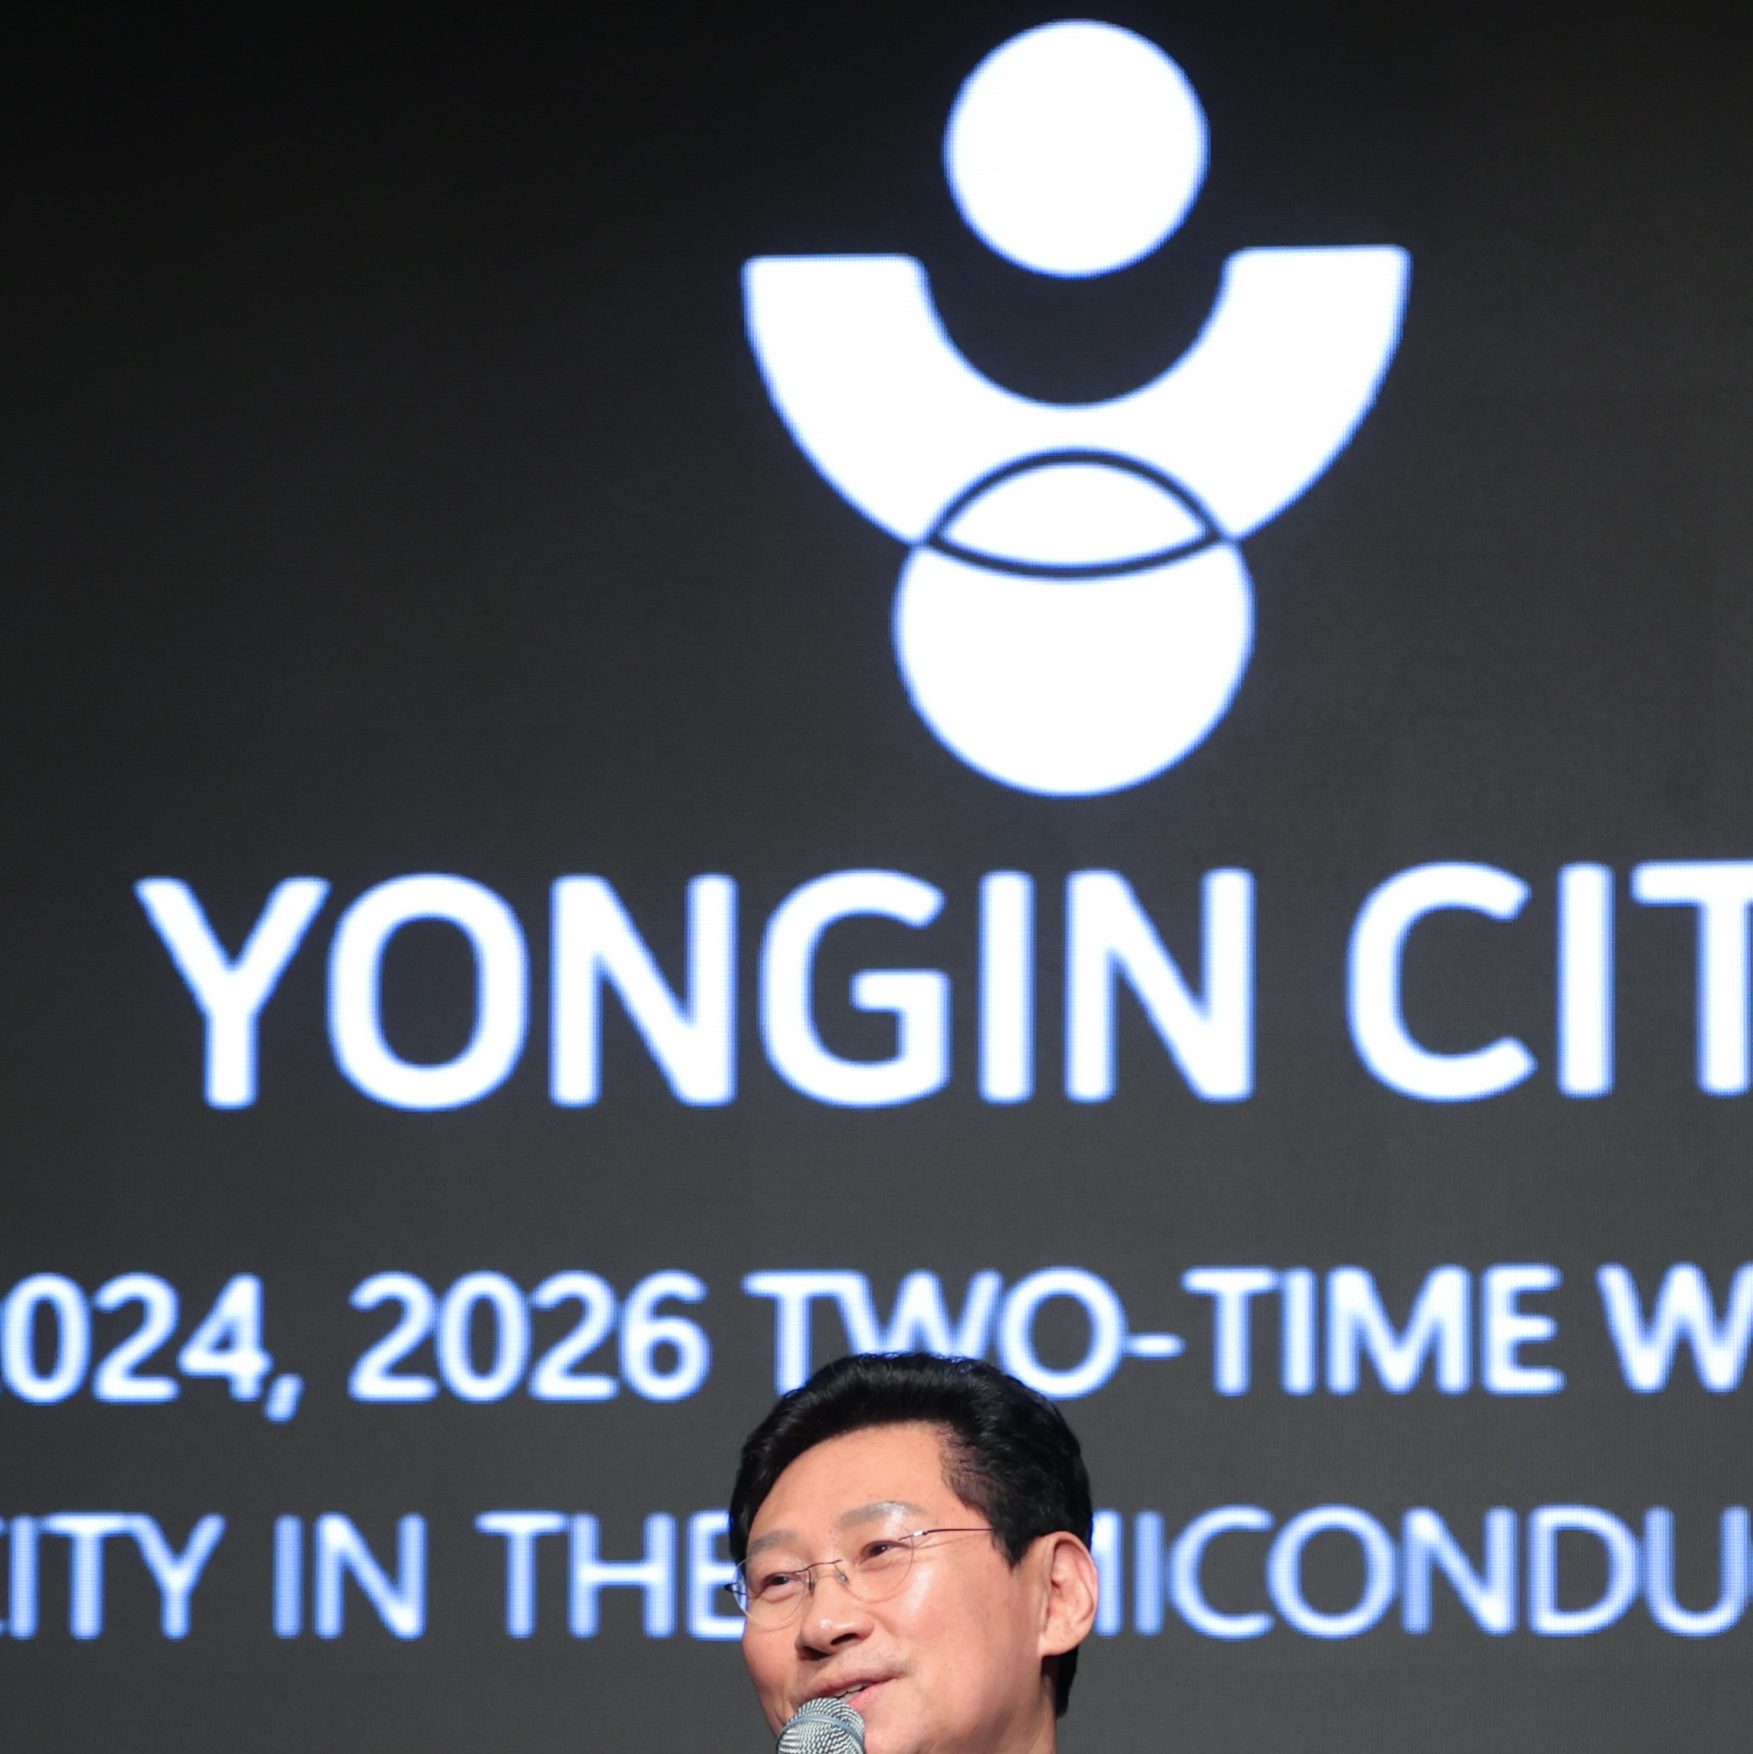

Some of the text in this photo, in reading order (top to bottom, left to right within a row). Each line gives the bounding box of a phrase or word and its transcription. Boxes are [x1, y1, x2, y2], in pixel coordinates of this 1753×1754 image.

[134, 866, 1257, 1113] YONGIN
[349, 1269, 713, 1404] 2026
[741, 1262, 1567, 1400] TWO-TIME
[272, 1512, 428, 1641] IN
